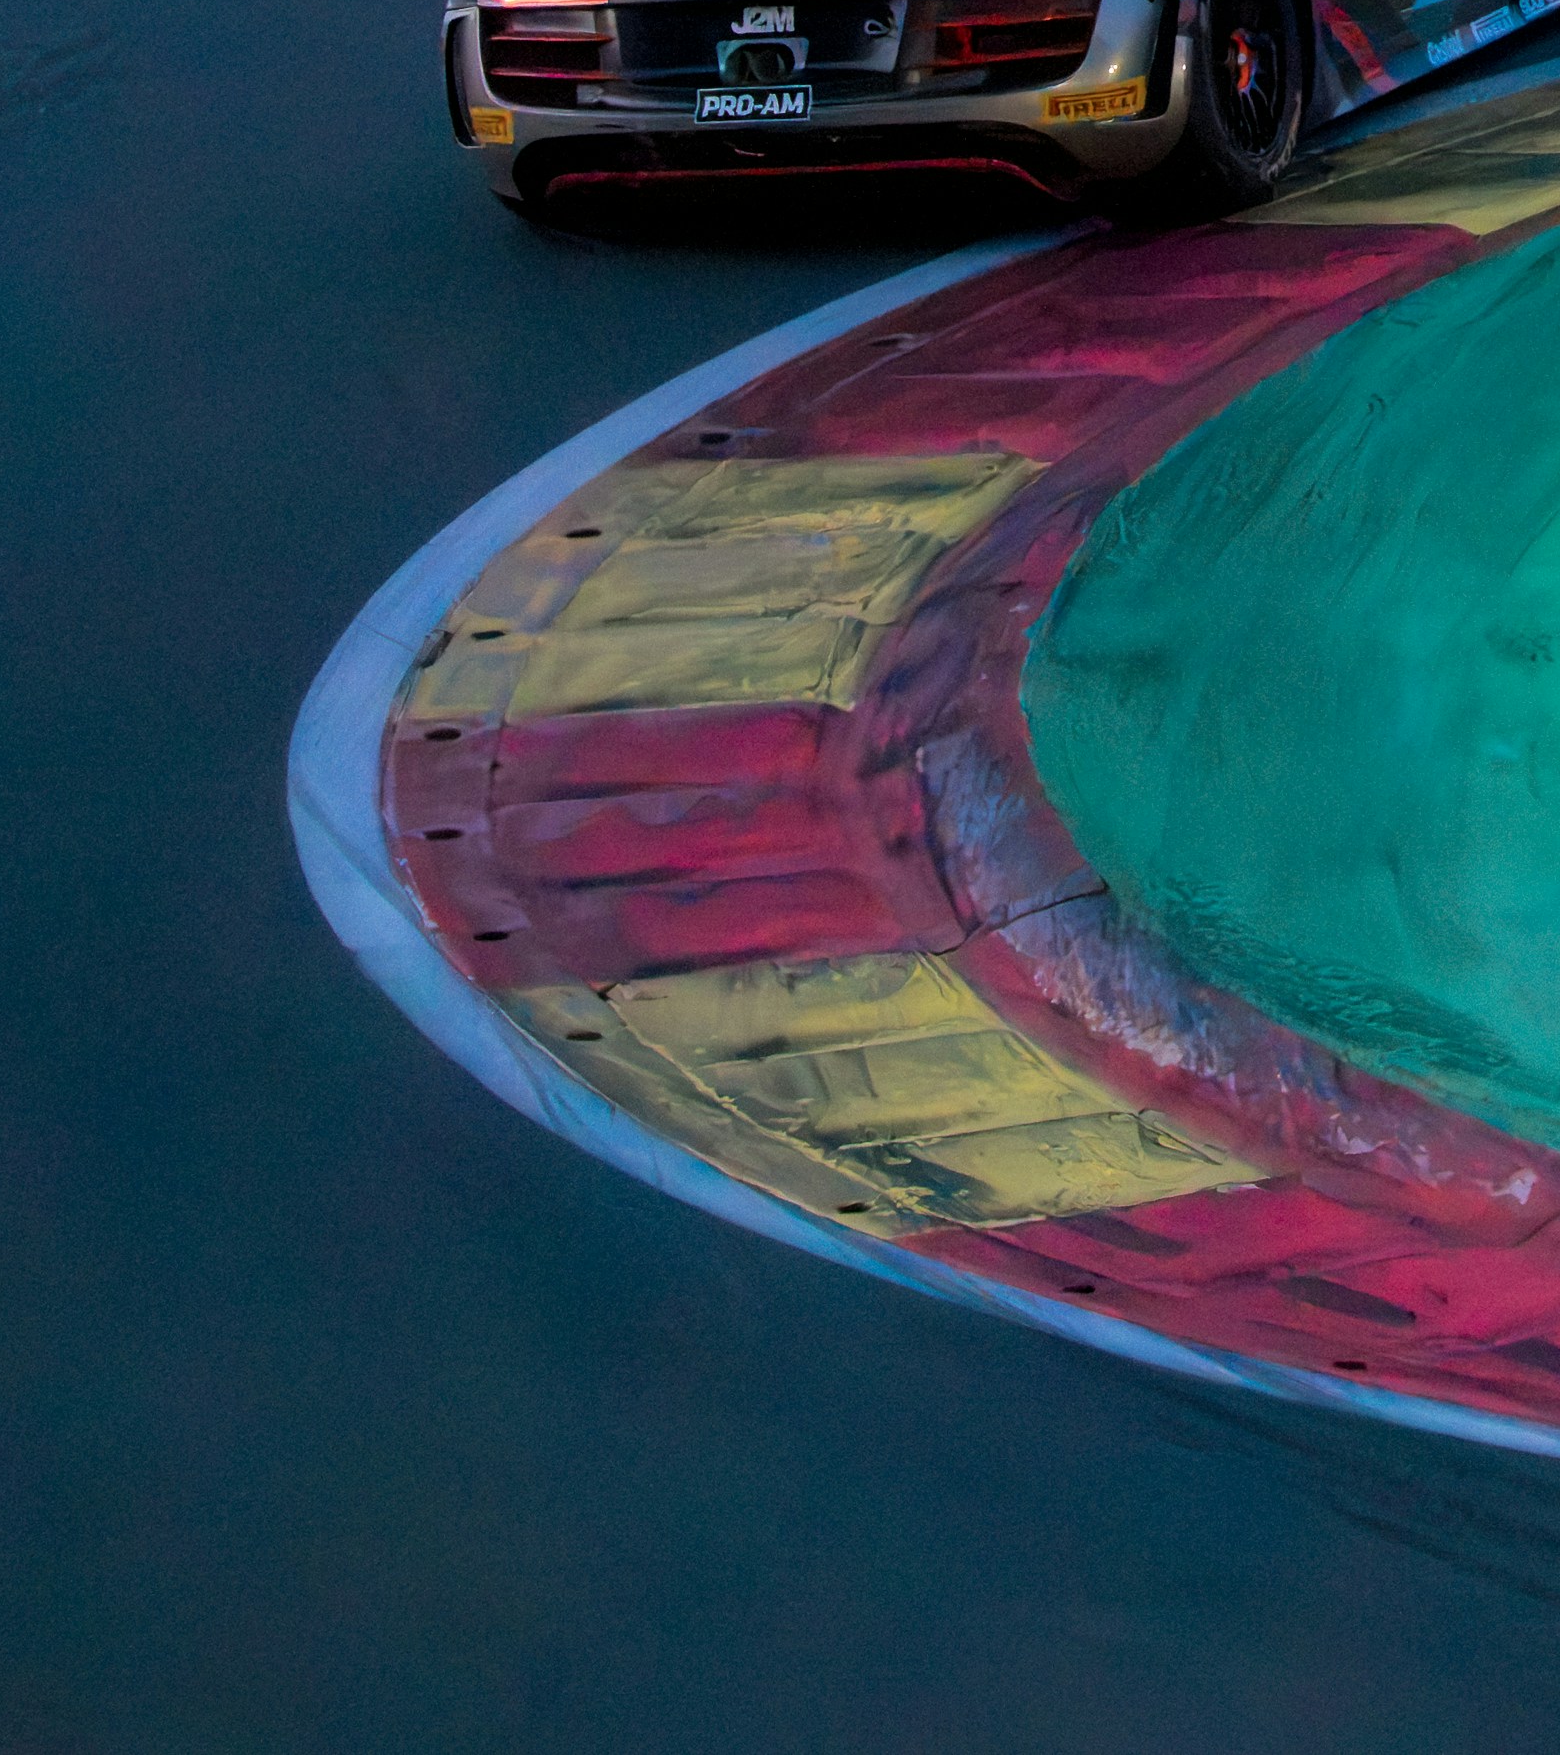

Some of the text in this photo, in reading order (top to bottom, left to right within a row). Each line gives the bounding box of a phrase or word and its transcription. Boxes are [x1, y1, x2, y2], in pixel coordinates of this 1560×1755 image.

[731, 6, 794, 34] J2M
[702, 93, 804, 118] PRO-AM
[1049, 86, 1137, 116] PIRELLI
